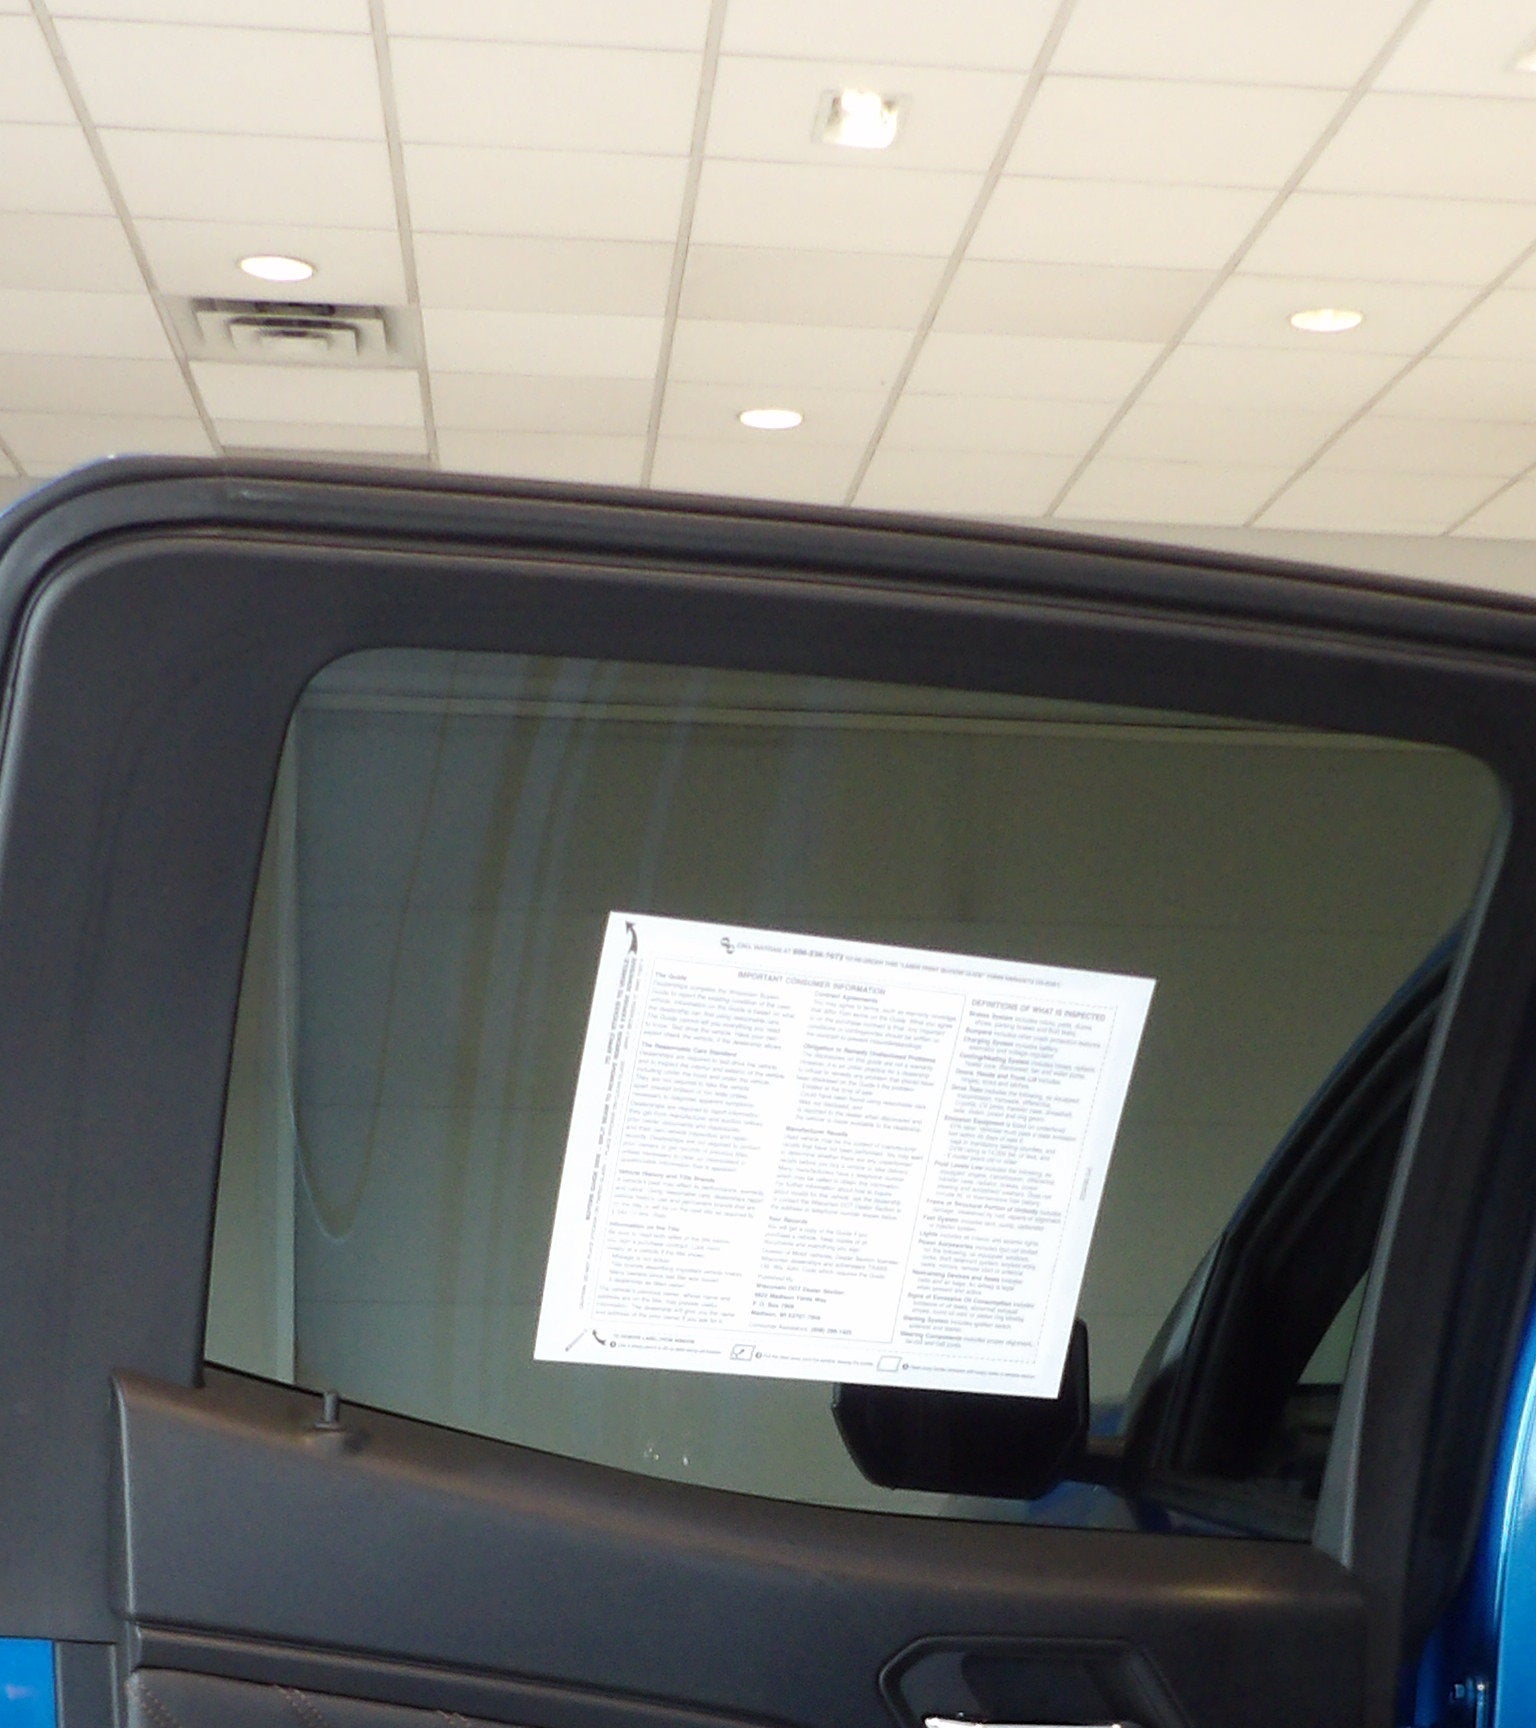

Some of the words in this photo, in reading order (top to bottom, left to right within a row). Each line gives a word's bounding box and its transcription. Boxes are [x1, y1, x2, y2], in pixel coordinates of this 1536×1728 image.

[737, 970, 783, 983] IMPORTANT
[784, 976, 831, 989] CONSUMER
[832, 982, 886, 995] INFORMATION
[970, 998, 1018, 1011] DEFINITIONS
[1019, 1003, 1030, 1013] OF
[1031, 1005, 1054, 1015] WHAT
[1054, 1008, 1063, 1017] IS
[1063, 1009, 1106, 1022] INSPECTED
